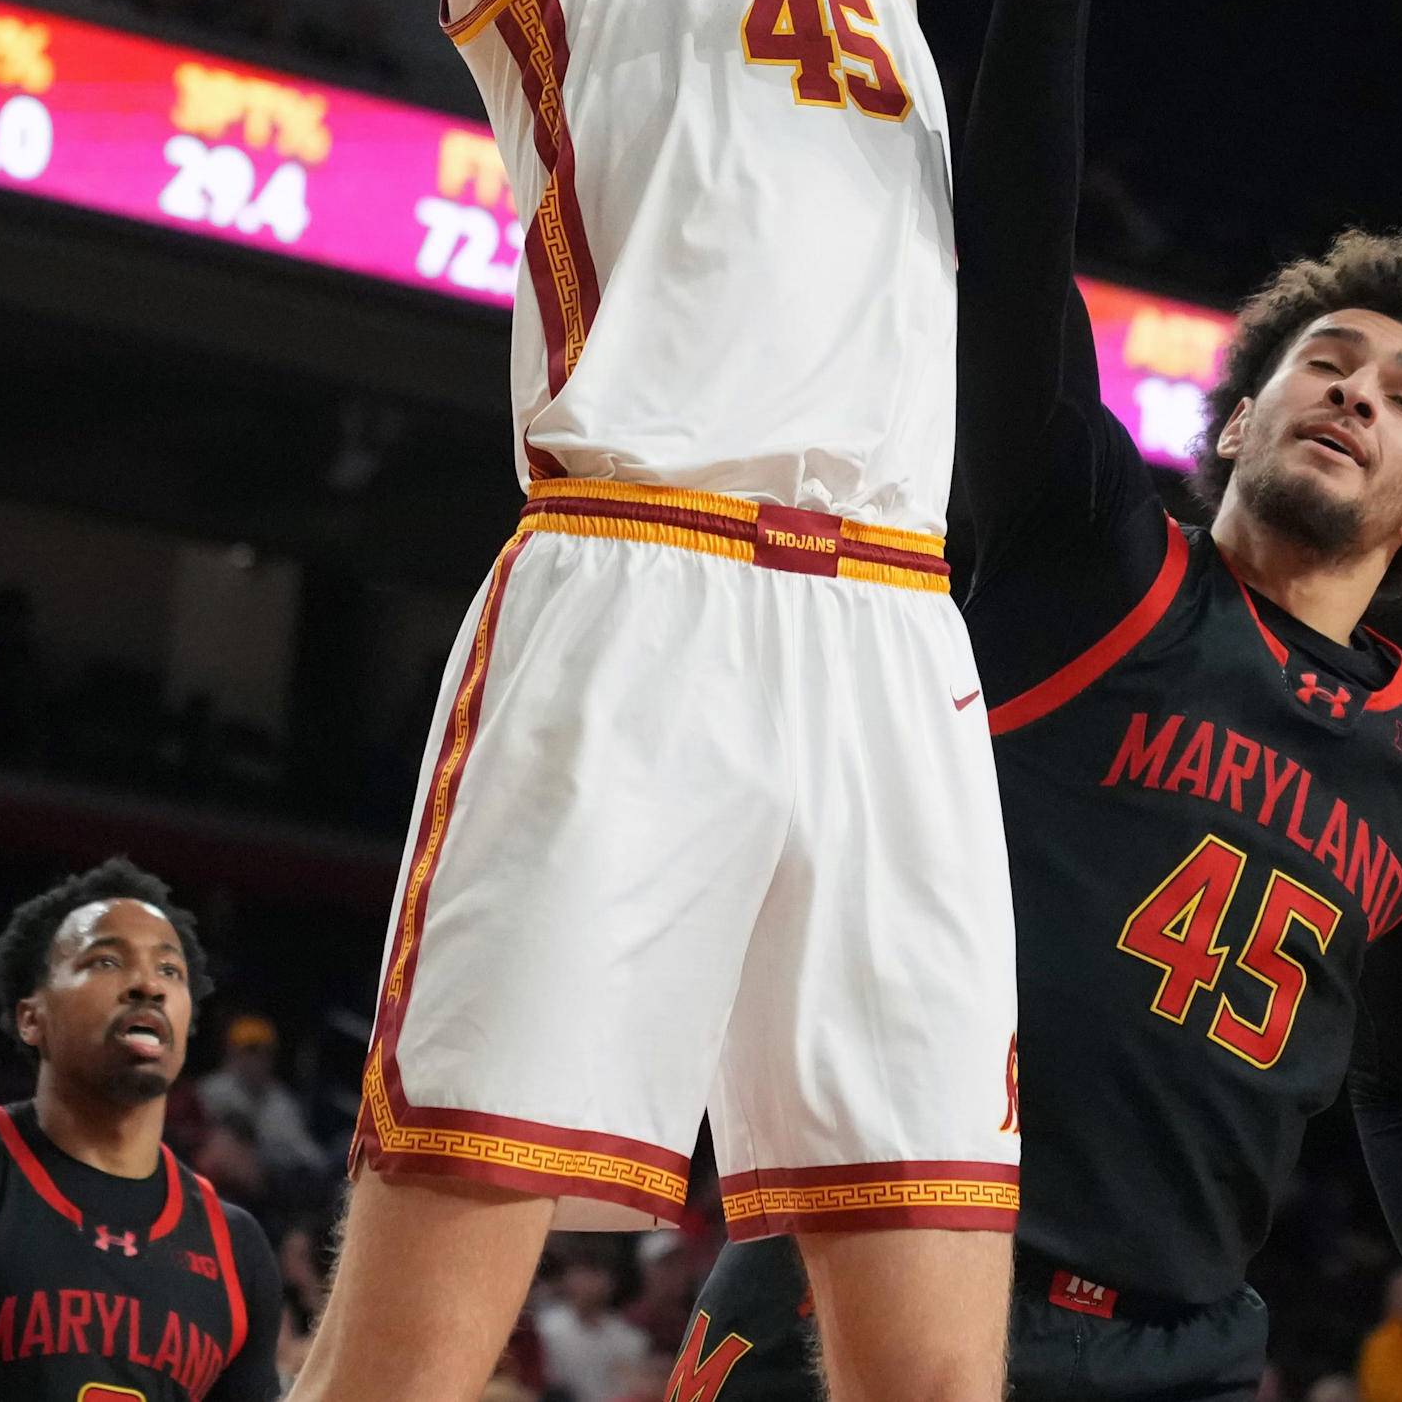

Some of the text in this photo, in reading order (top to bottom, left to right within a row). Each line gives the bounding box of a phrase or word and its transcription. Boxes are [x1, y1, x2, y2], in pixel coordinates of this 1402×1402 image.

[158, 134, 310, 243] 29.4
[415, 196, 525, 294] 72.
[765, 529, 836, 554] TROJANS
[1116, 833, 1343, 1070] 45
